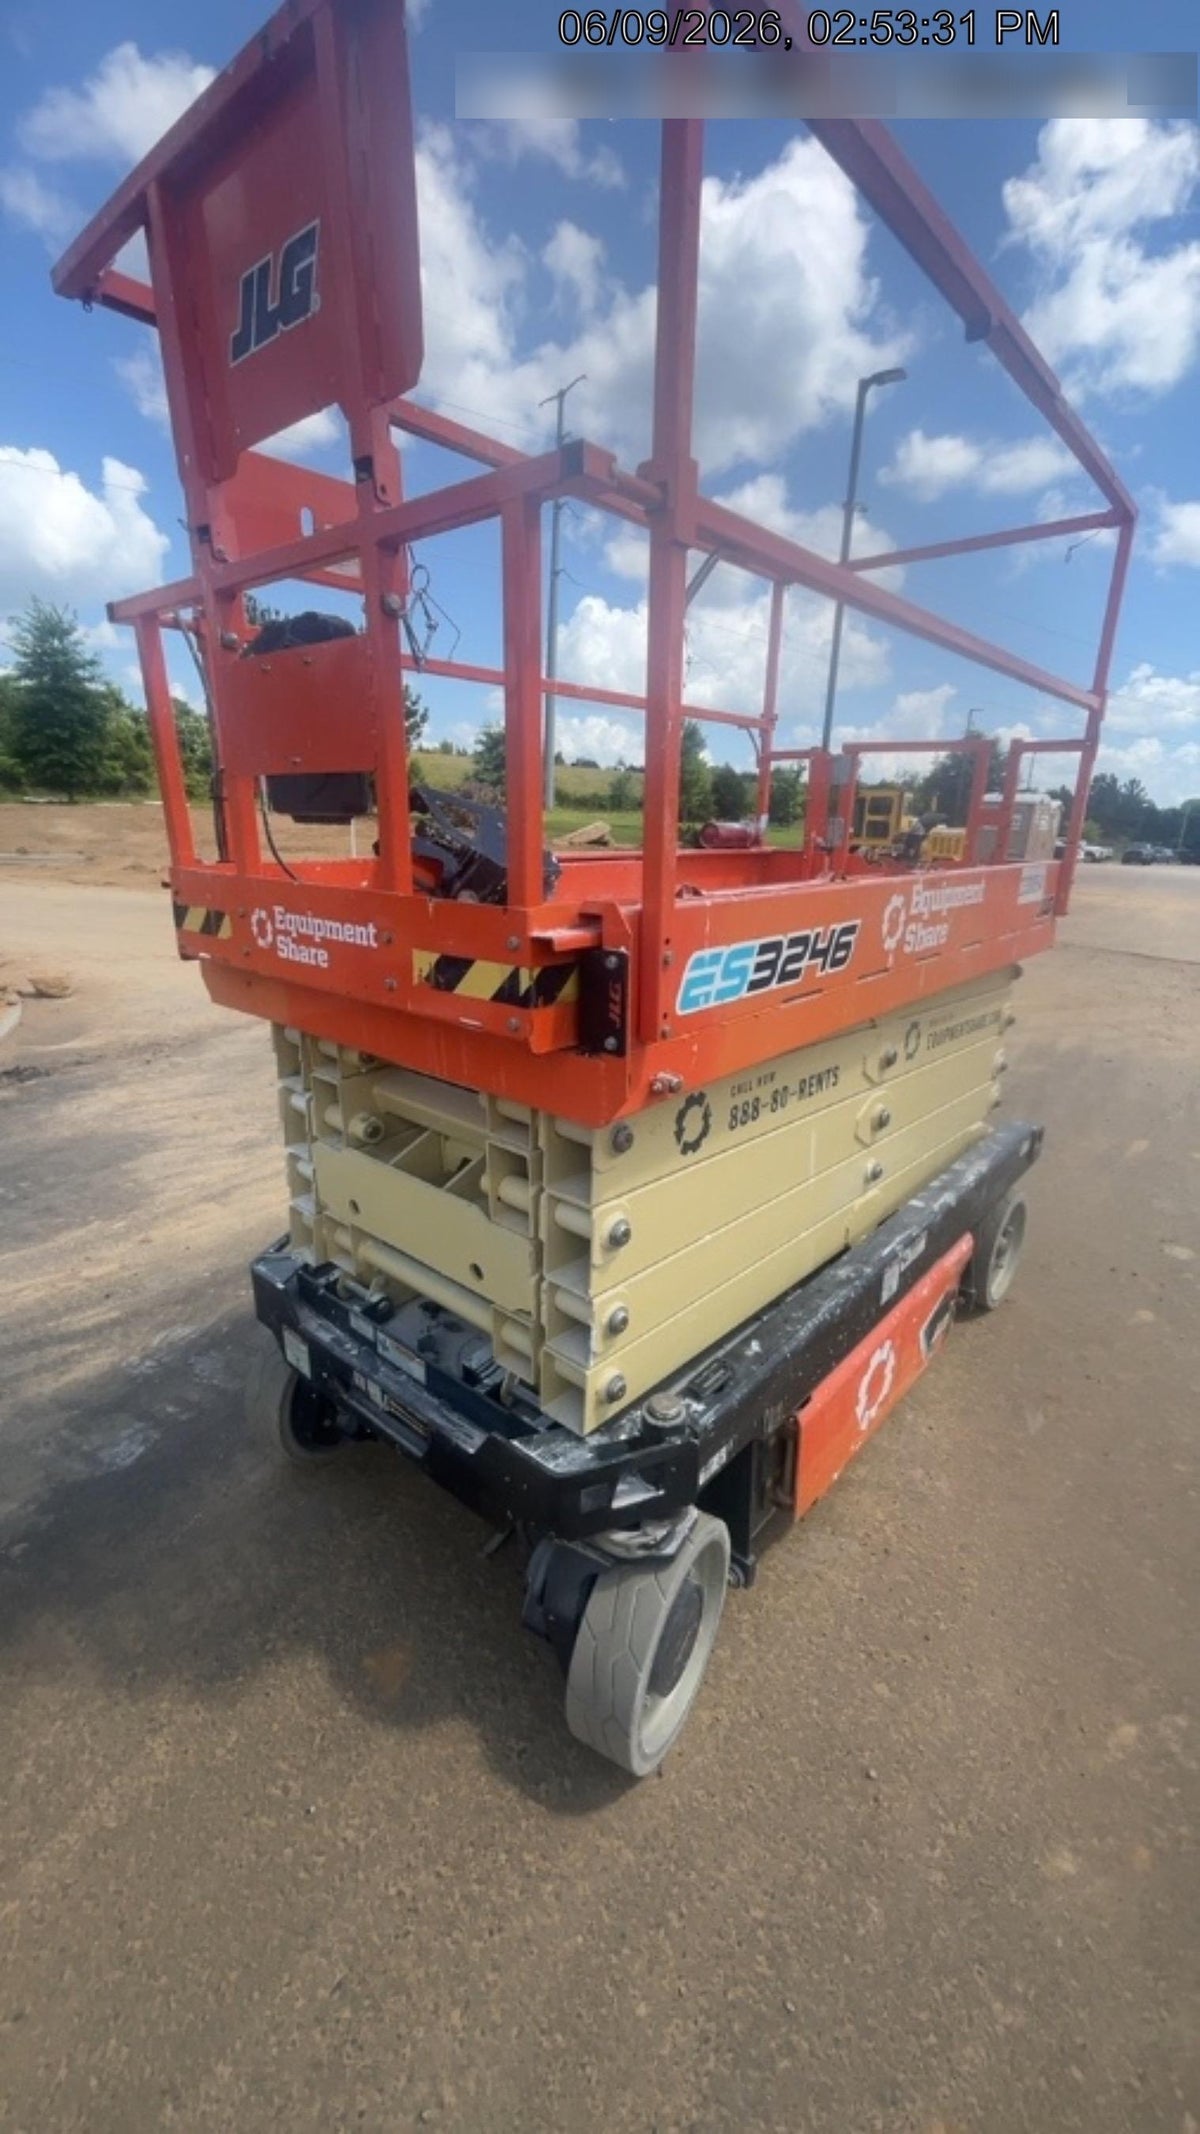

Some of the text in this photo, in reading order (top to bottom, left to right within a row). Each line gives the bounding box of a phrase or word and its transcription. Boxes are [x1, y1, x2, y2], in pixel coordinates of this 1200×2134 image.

[229, 217, 320, 367] JLG
[909, 877, 986, 920] Equipment
[272, 905, 378, 949] Equipment
[903, 922, 949, 954] Share
[276, 935, 329, 968] Share
[676, 921, 861, 1015] ES3246
[608, 981, 622, 1030] JLG
[728, 1065, 840, 1131] 888-80-RENTS
